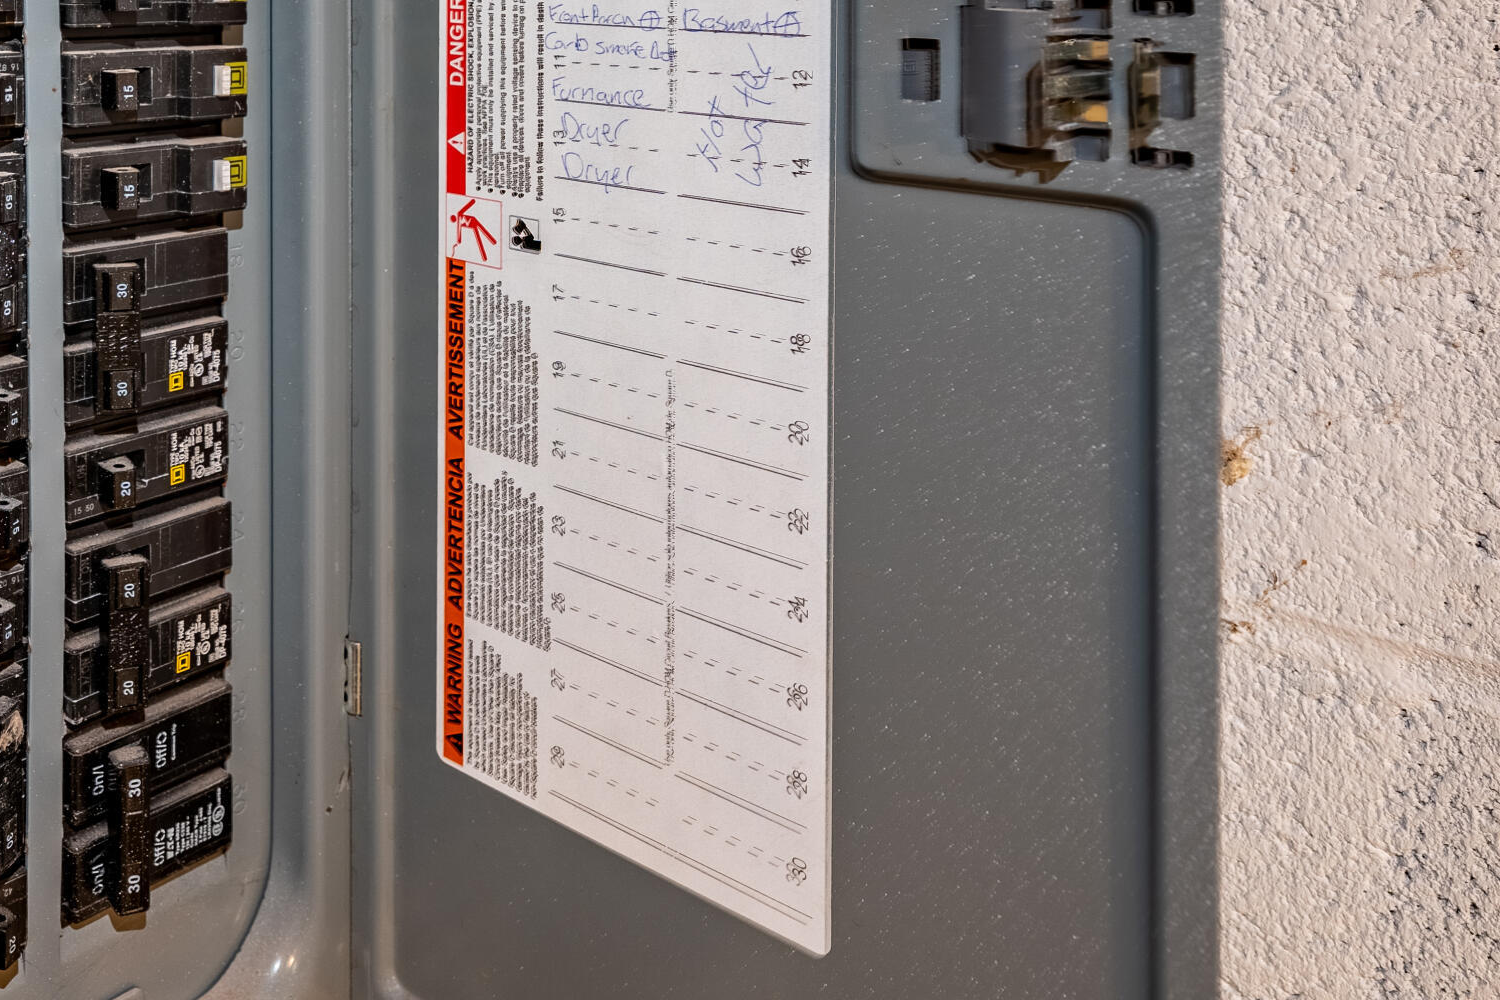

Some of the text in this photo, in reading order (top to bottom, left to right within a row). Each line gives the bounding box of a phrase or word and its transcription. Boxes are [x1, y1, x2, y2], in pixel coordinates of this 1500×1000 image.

[5, 86, 12, 102] 15
[123, 85, 134, 99] 15
[467, 126, 474, 137] OF
[124, 184, 134, 198] 15
[5, 195, 12, 209] 50
[117, 283, 127, 298] 30
[4, 301, 11, 316] 50
[449, 260, 464, 441] AVERTISSEMENT
[117, 382, 128, 397] 30
[11, 410, 18, 426] 15
[121, 481, 131, 497] 20
[12, 519, 19, 535] 15
[448, 458, 463, 610] ADVERTENCIA
[124, 583, 135, 598] 20
[447, 623, 462, 725] WARNING
[124, 680, 134, 695] 20
[128, 779, 141, 798] 30
[6, 832, 13, 849] 30
[128, 875, 140, 893] 30
[9, 936, 16, 954] 20
